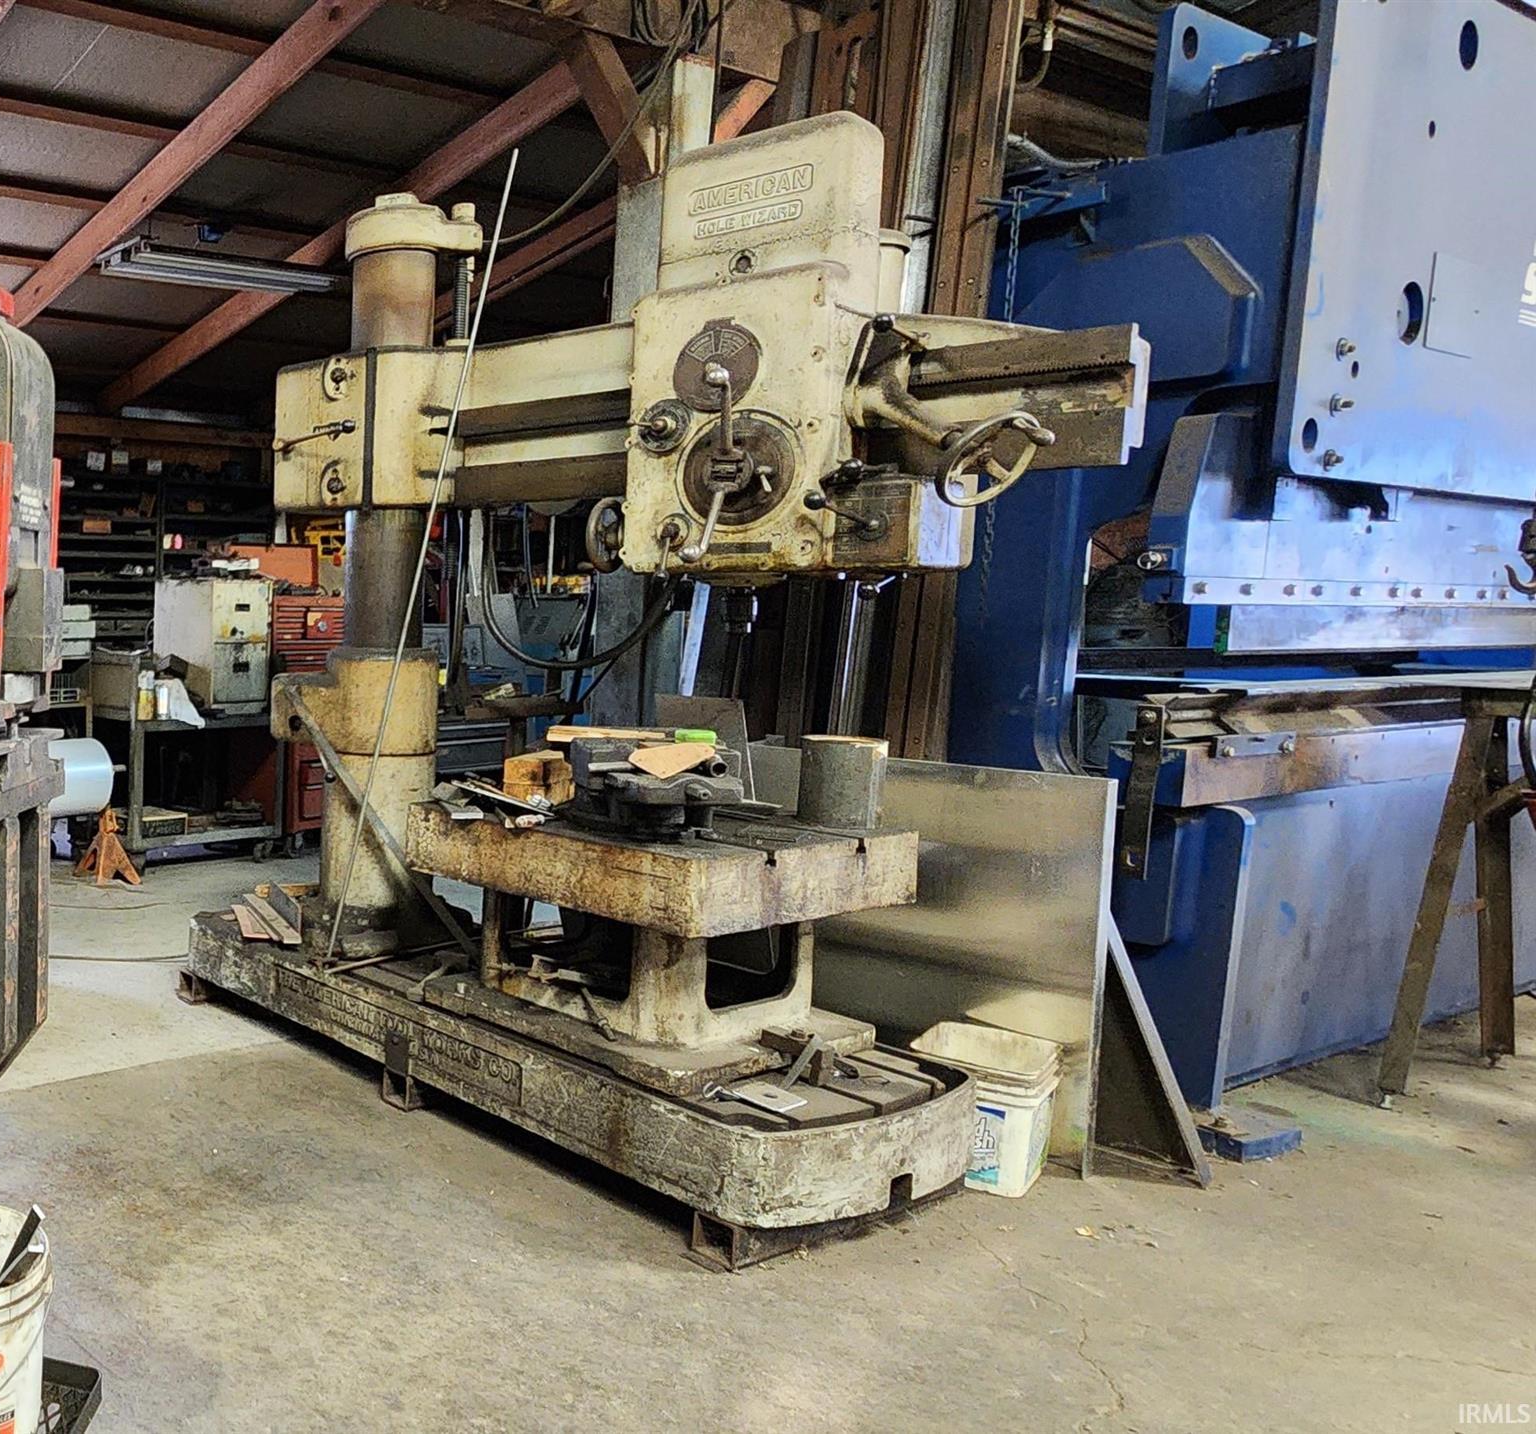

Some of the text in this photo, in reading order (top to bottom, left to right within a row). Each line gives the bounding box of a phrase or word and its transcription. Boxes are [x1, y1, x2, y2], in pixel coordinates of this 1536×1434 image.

[693, 167, 809, 213] AMERICAN
[697, 203, 800, 236] HOLE WIZARD
[419, 1027, 482, 1070] WORKS
